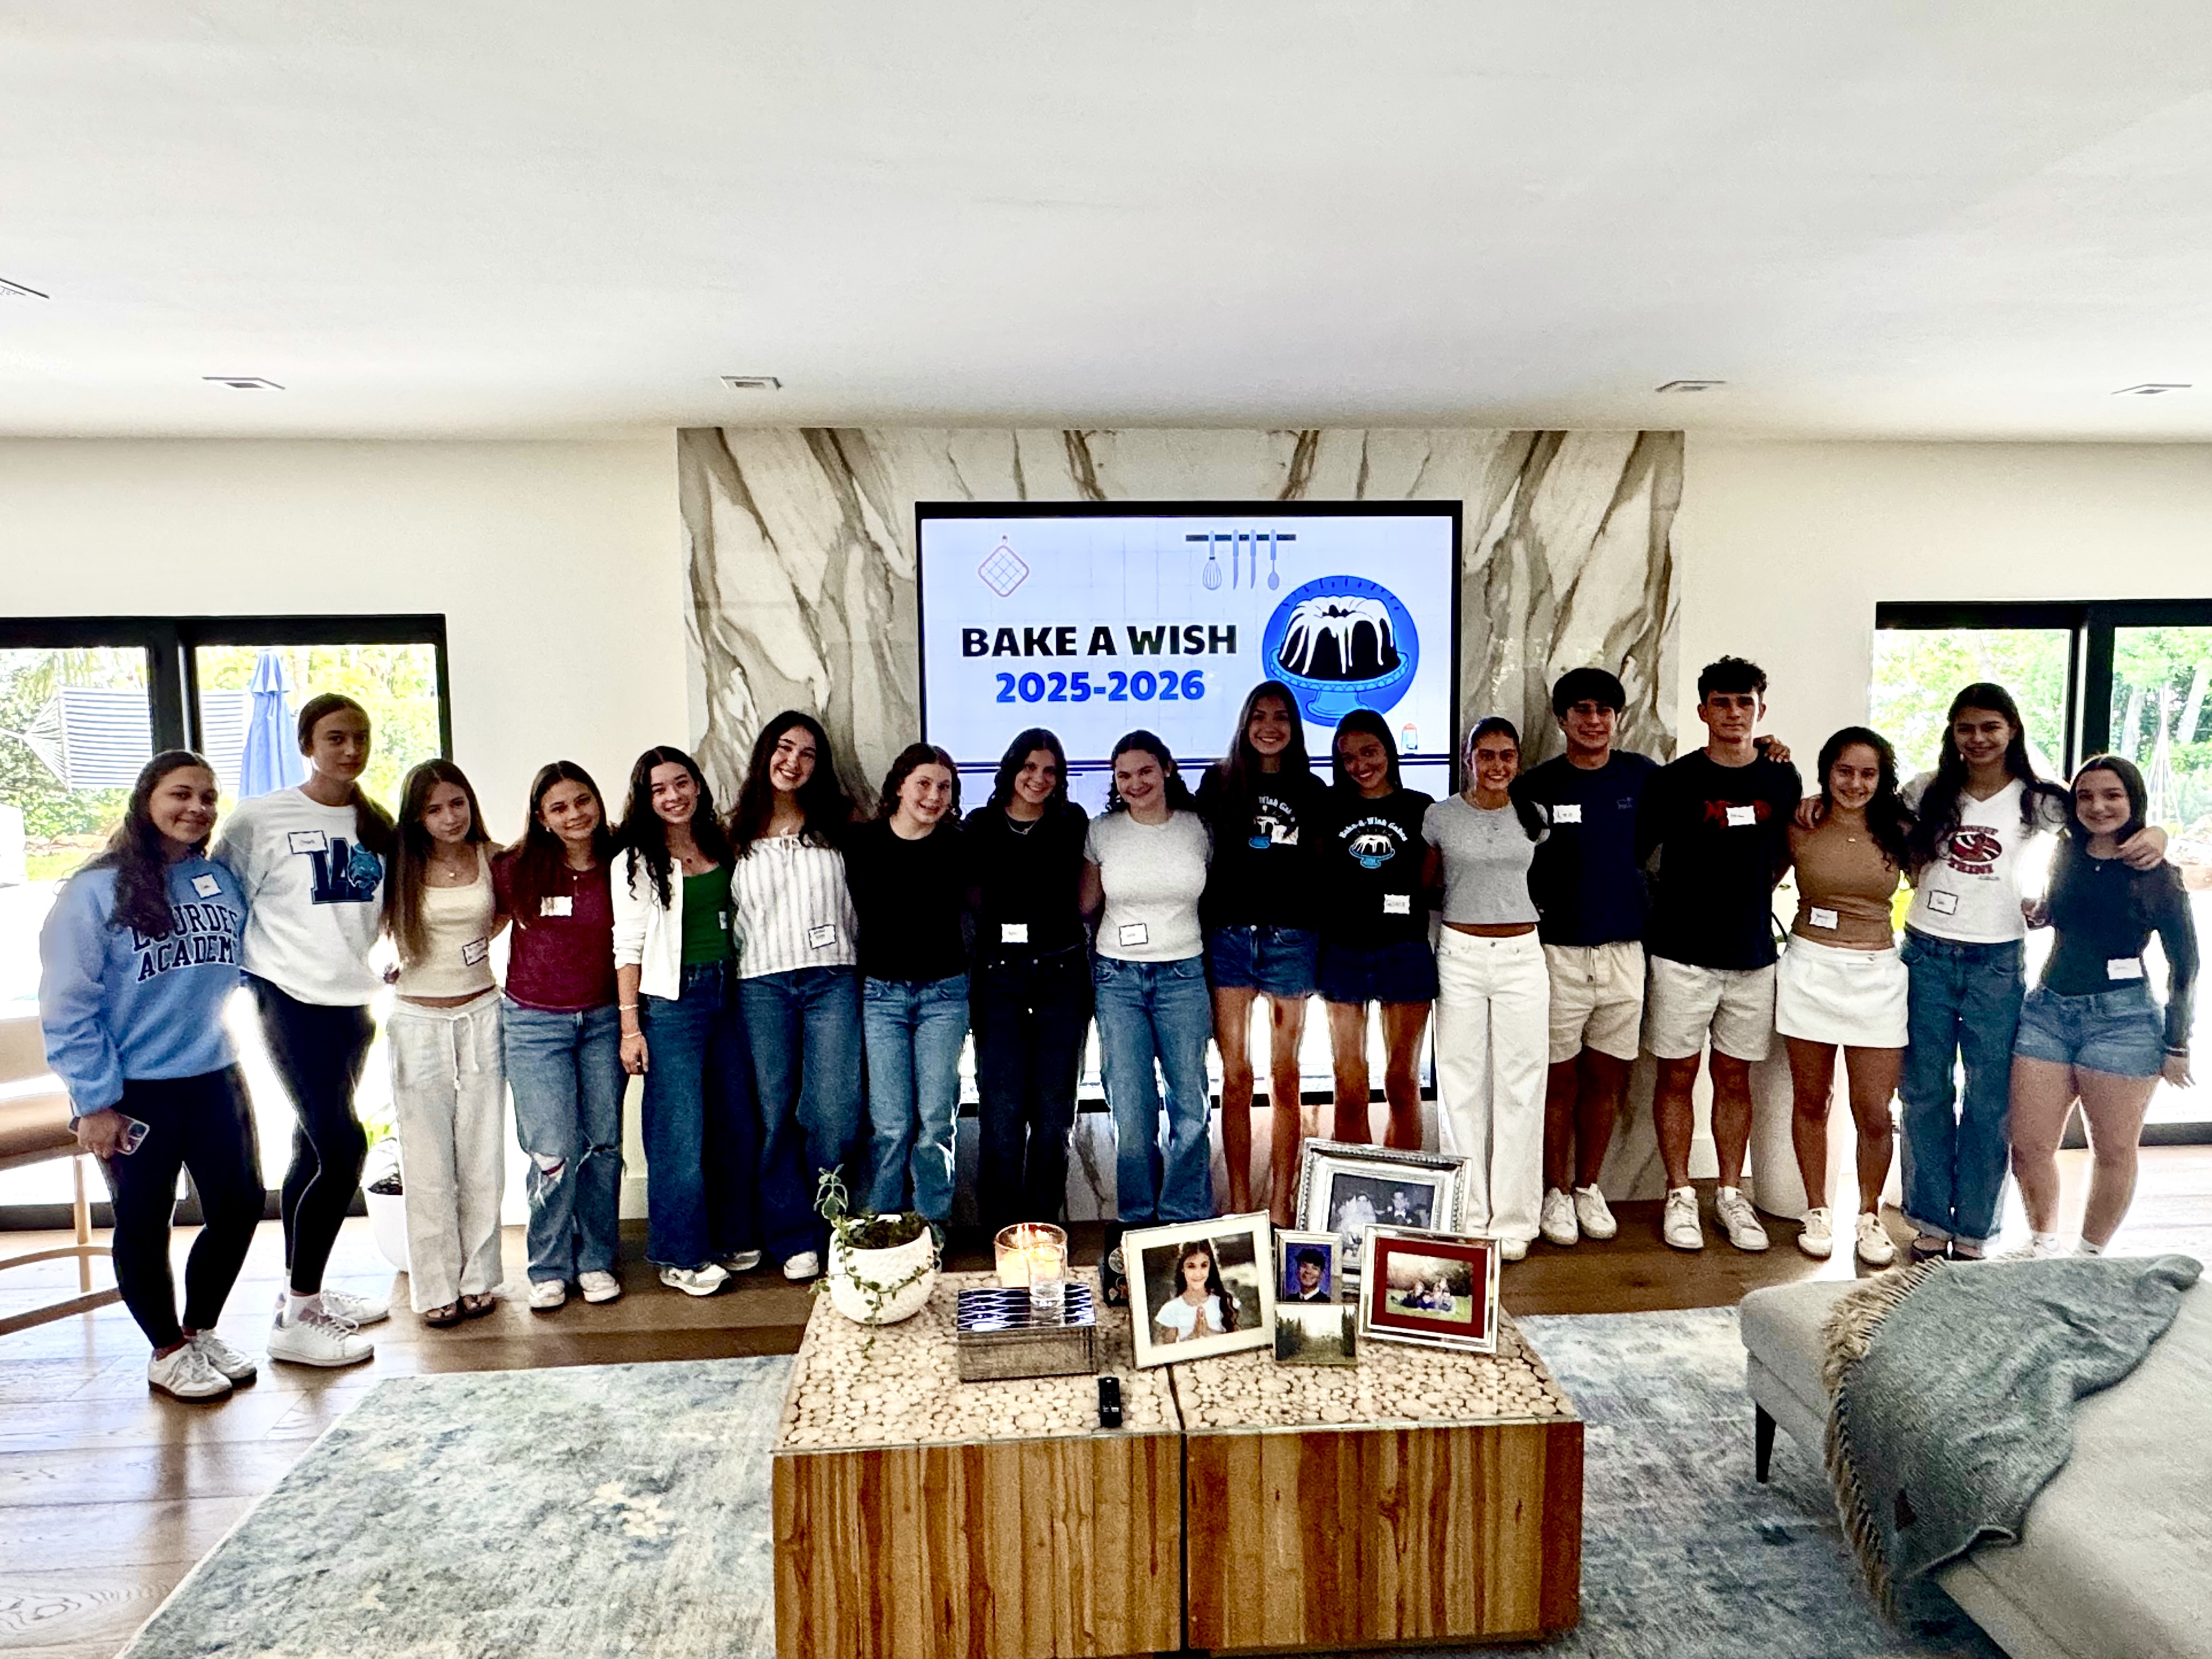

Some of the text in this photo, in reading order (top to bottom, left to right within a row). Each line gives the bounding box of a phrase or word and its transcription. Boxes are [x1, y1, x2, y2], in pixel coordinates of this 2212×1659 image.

[962, 625, 1236, 656] BAKE A WISH
[996, 670, 1205, 702] 2025-2026
[137, 934, 238, 983] ACADEM
